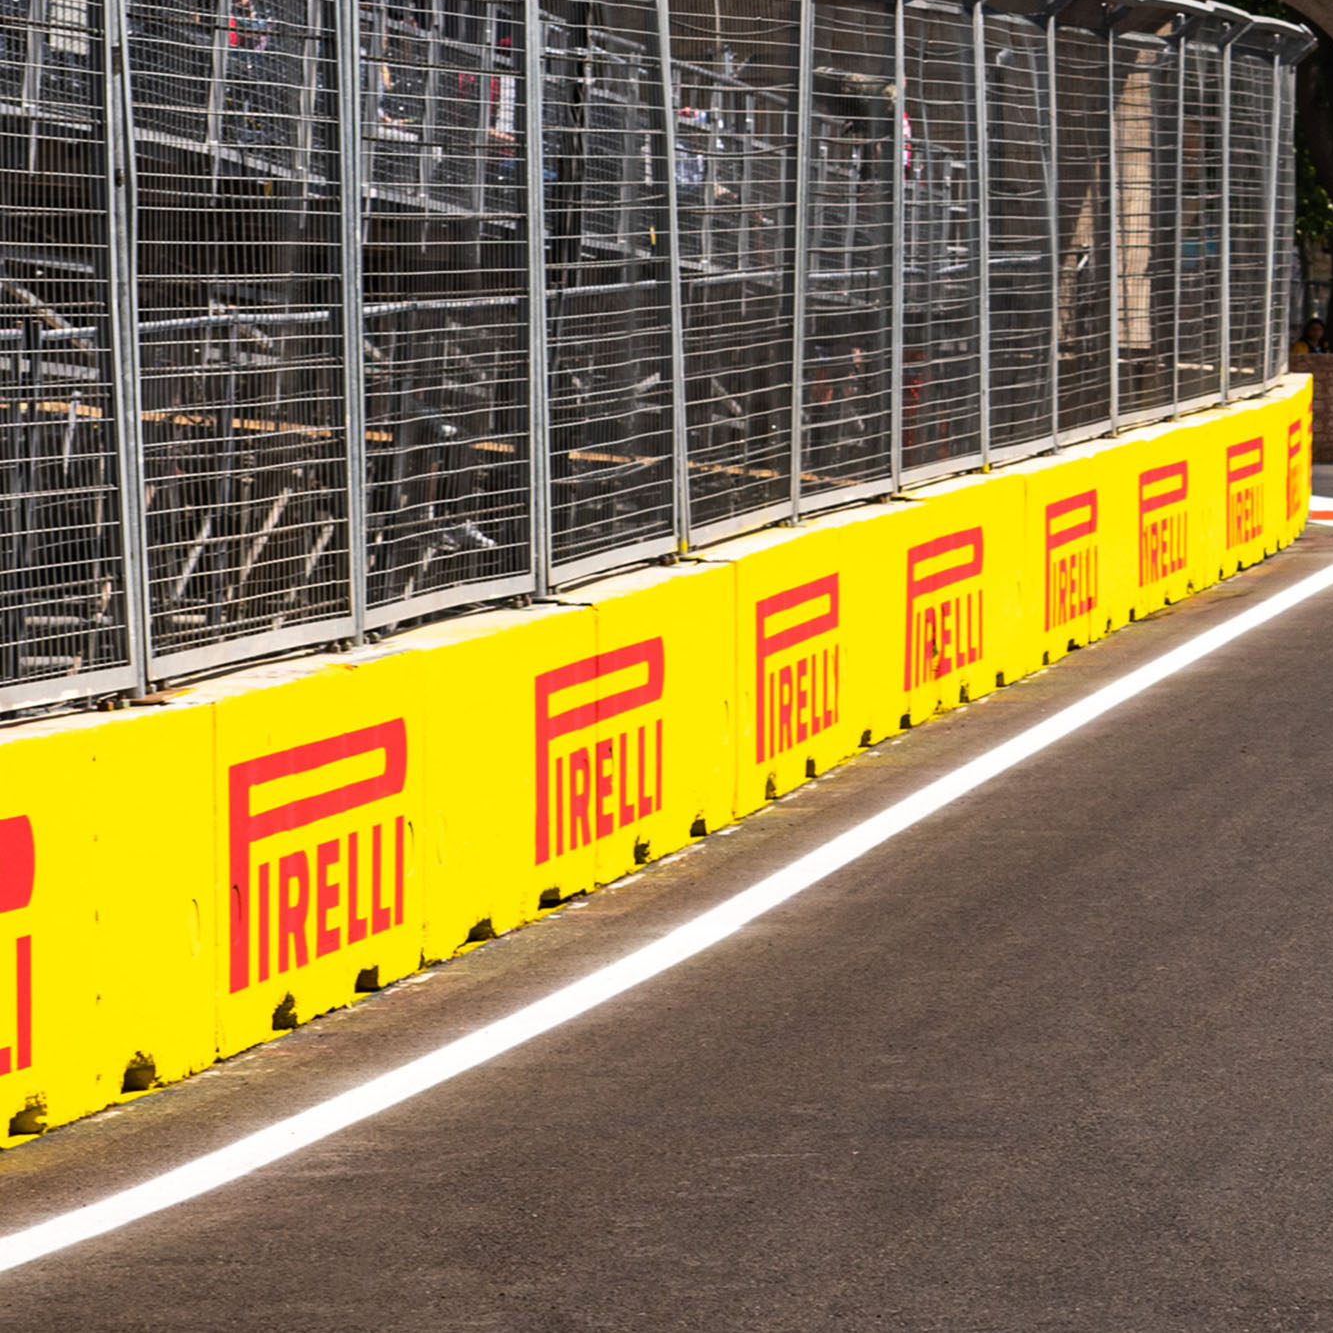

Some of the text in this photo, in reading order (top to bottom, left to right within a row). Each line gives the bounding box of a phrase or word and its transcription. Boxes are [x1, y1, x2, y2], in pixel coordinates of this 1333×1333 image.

[1044, 489, 1098, 632] PIRELLI
[1138, 460, 1189, 587] PIRELLI
[1227, 437, 1264, 548] PIRELLI
[755, 572, 840, 765] PIRELLI
[904, 527, 984, 693] PIRELLI
[534, 636, 665, 866] PIRELLI
[229, 717, 408, 994] PIRELLI
